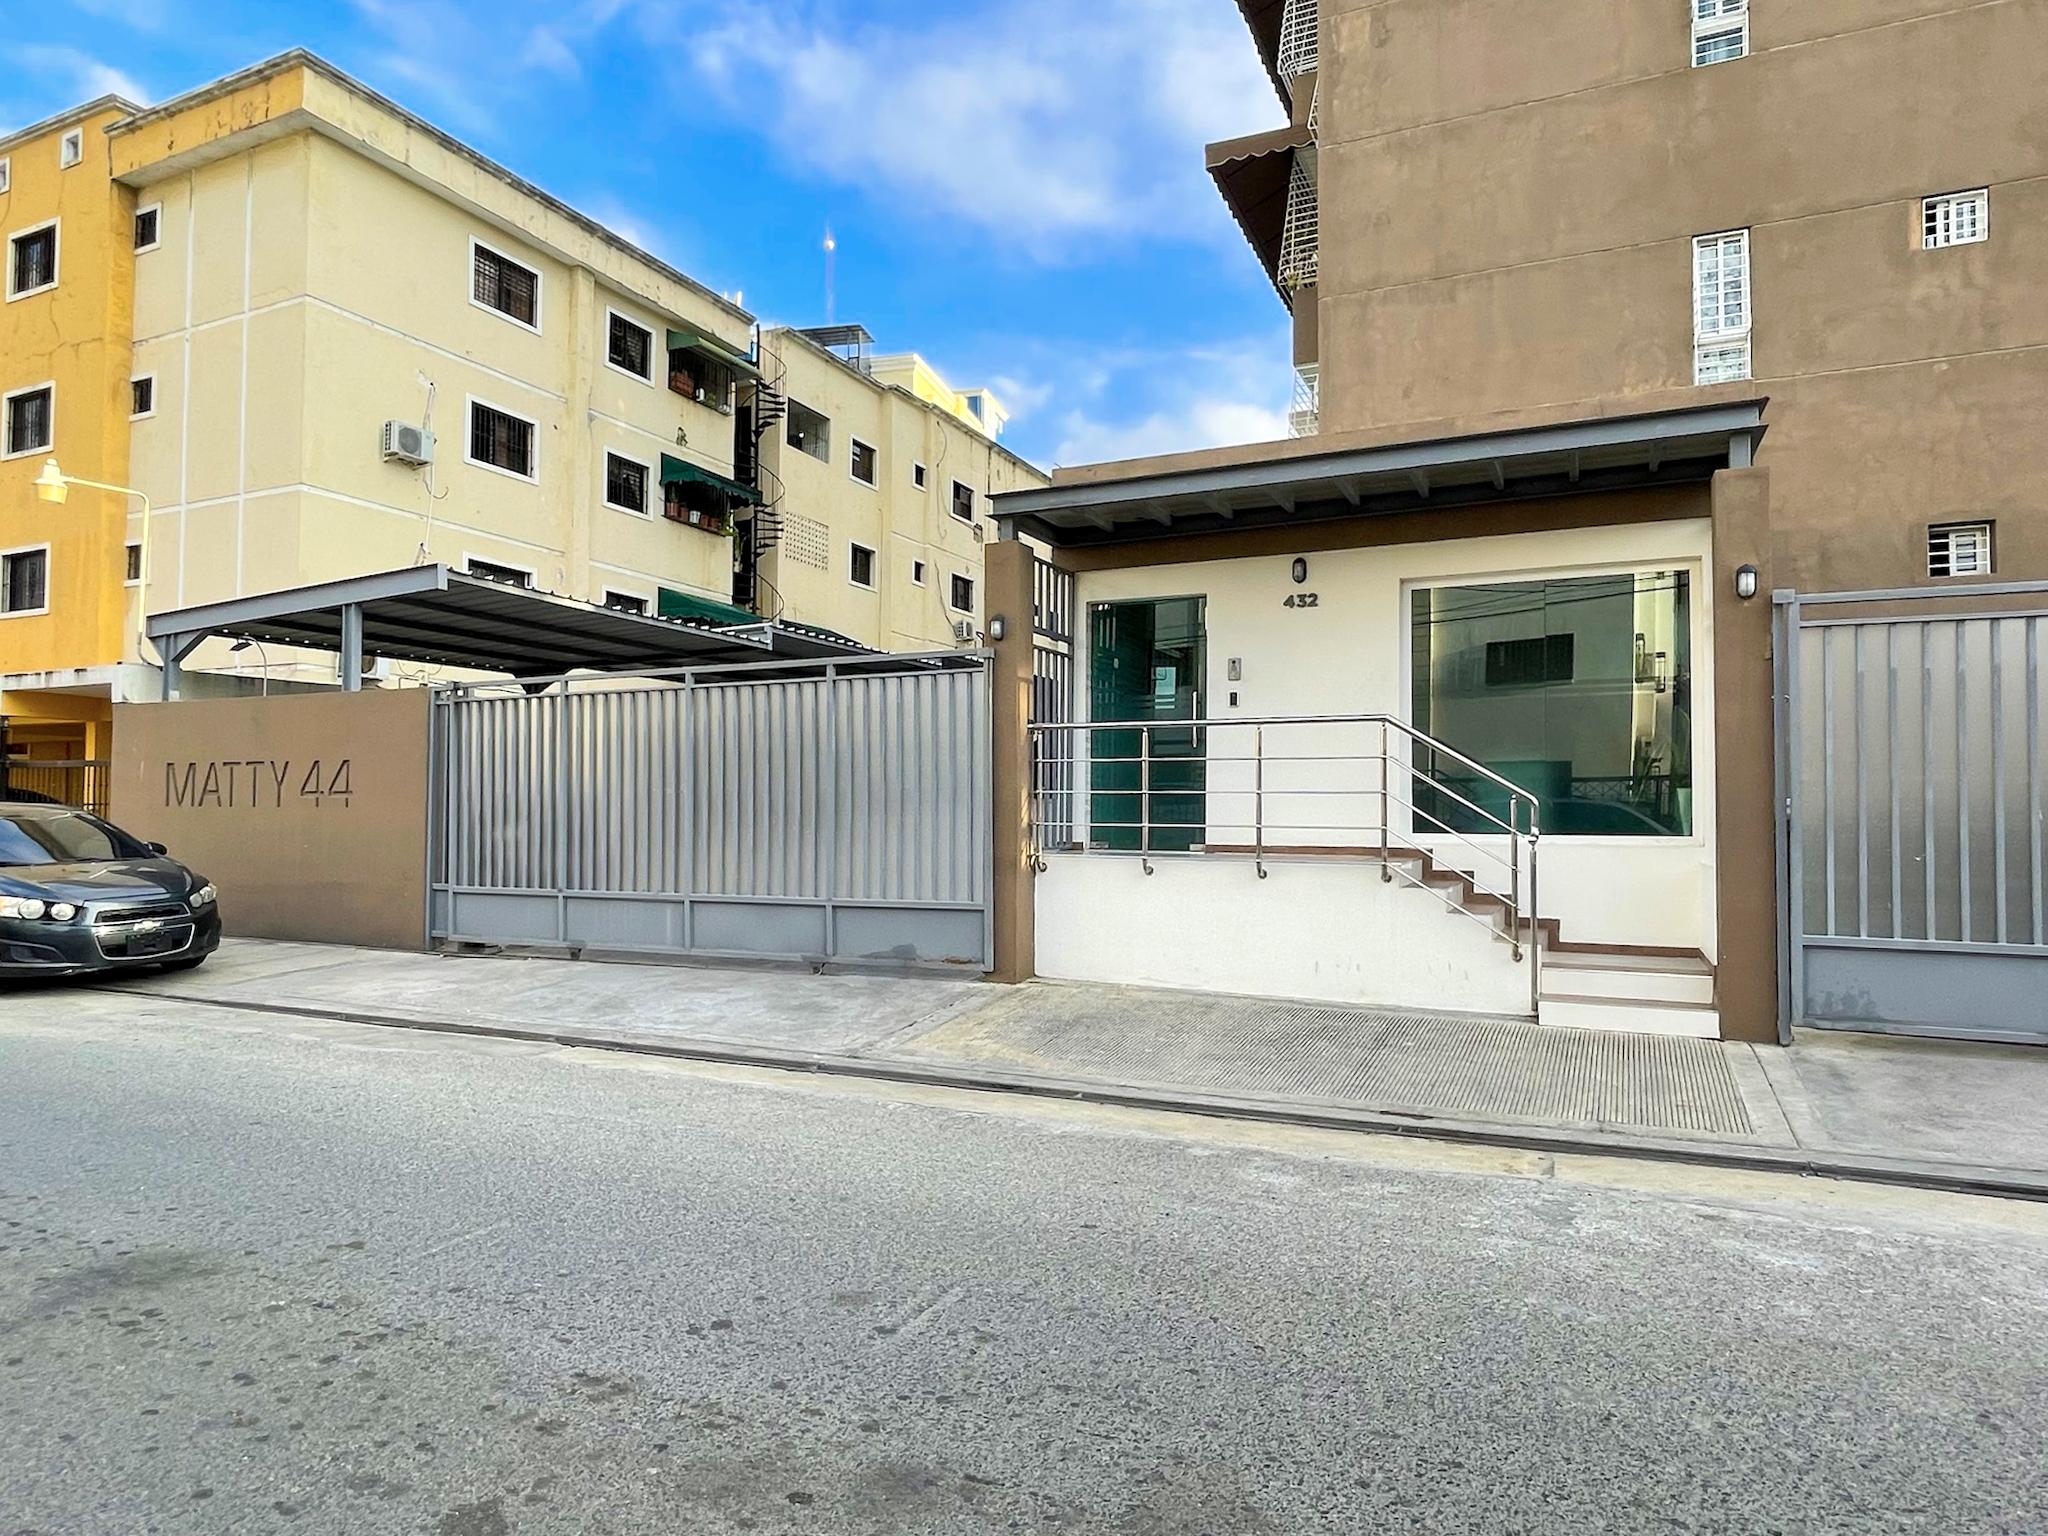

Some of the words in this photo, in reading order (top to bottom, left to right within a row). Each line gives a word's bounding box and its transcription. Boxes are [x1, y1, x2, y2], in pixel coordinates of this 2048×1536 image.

[1283, 592, 1319, 608] 432
[165, 760, 289, 807] MATTY
[300, 759, 353, 807] 44
